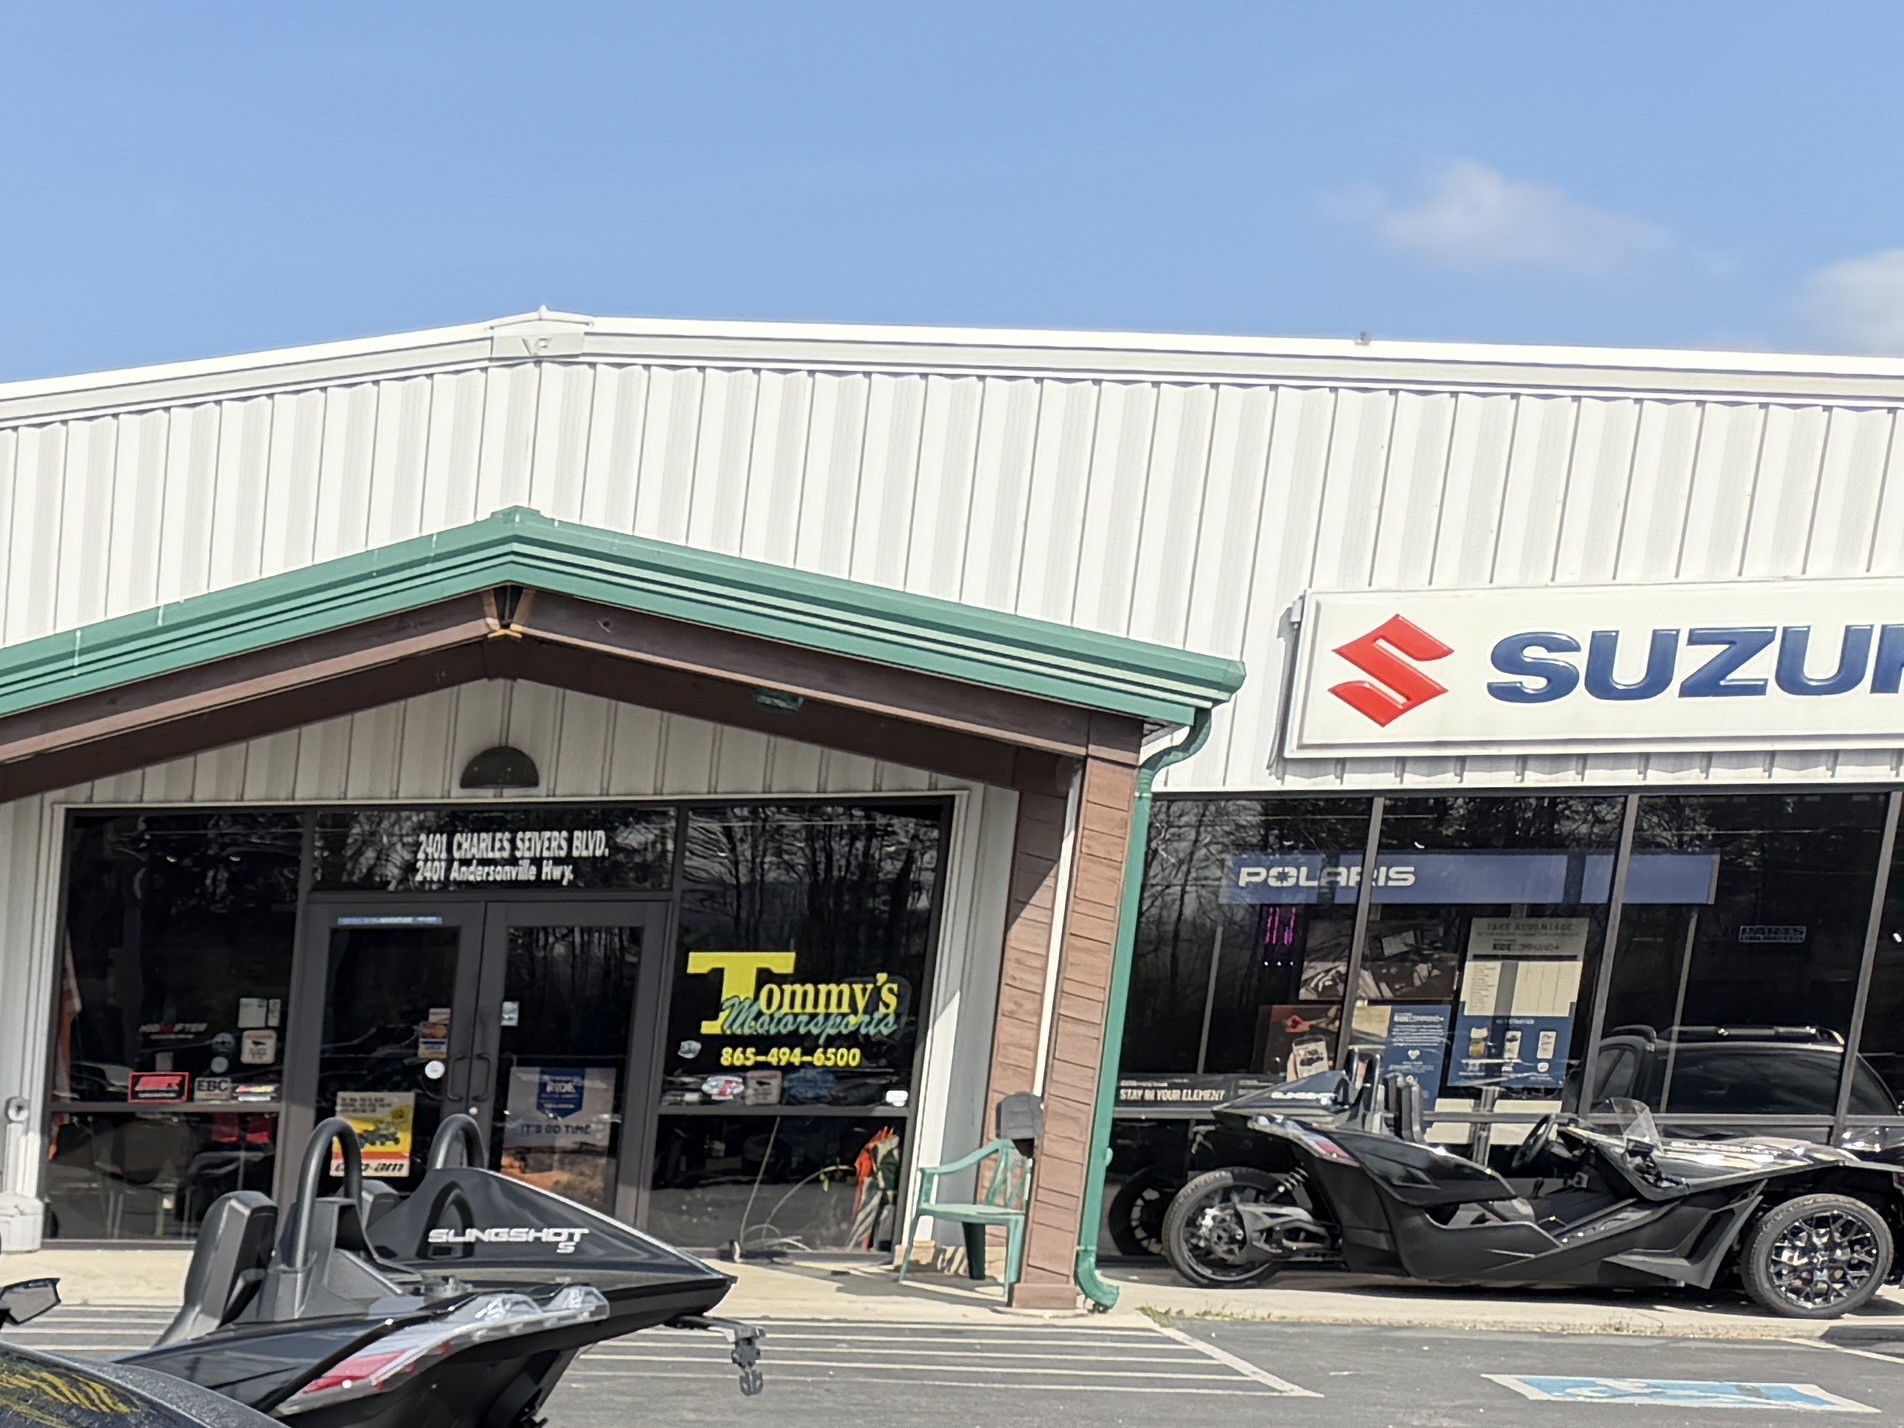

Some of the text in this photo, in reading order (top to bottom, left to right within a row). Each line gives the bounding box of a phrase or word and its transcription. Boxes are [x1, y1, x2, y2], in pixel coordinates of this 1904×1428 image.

[417, 830, 609, 859] 2401 CHARLES SEIVERS BLVD.
[415, 861, 446, 881] 2401
[449, 860, 537, 882] Andersonville
[687, 952, 898, 1035] Tommy's
[721, 996, 898, 1045] Motorsports
[720, 1047, 861, 1067] 865-494-6500
[196, 1079, 229, 1092] EBC
[428, 1228, 590, 1243] SLINGSHOT
[556, 1242, 576, 1254] S
